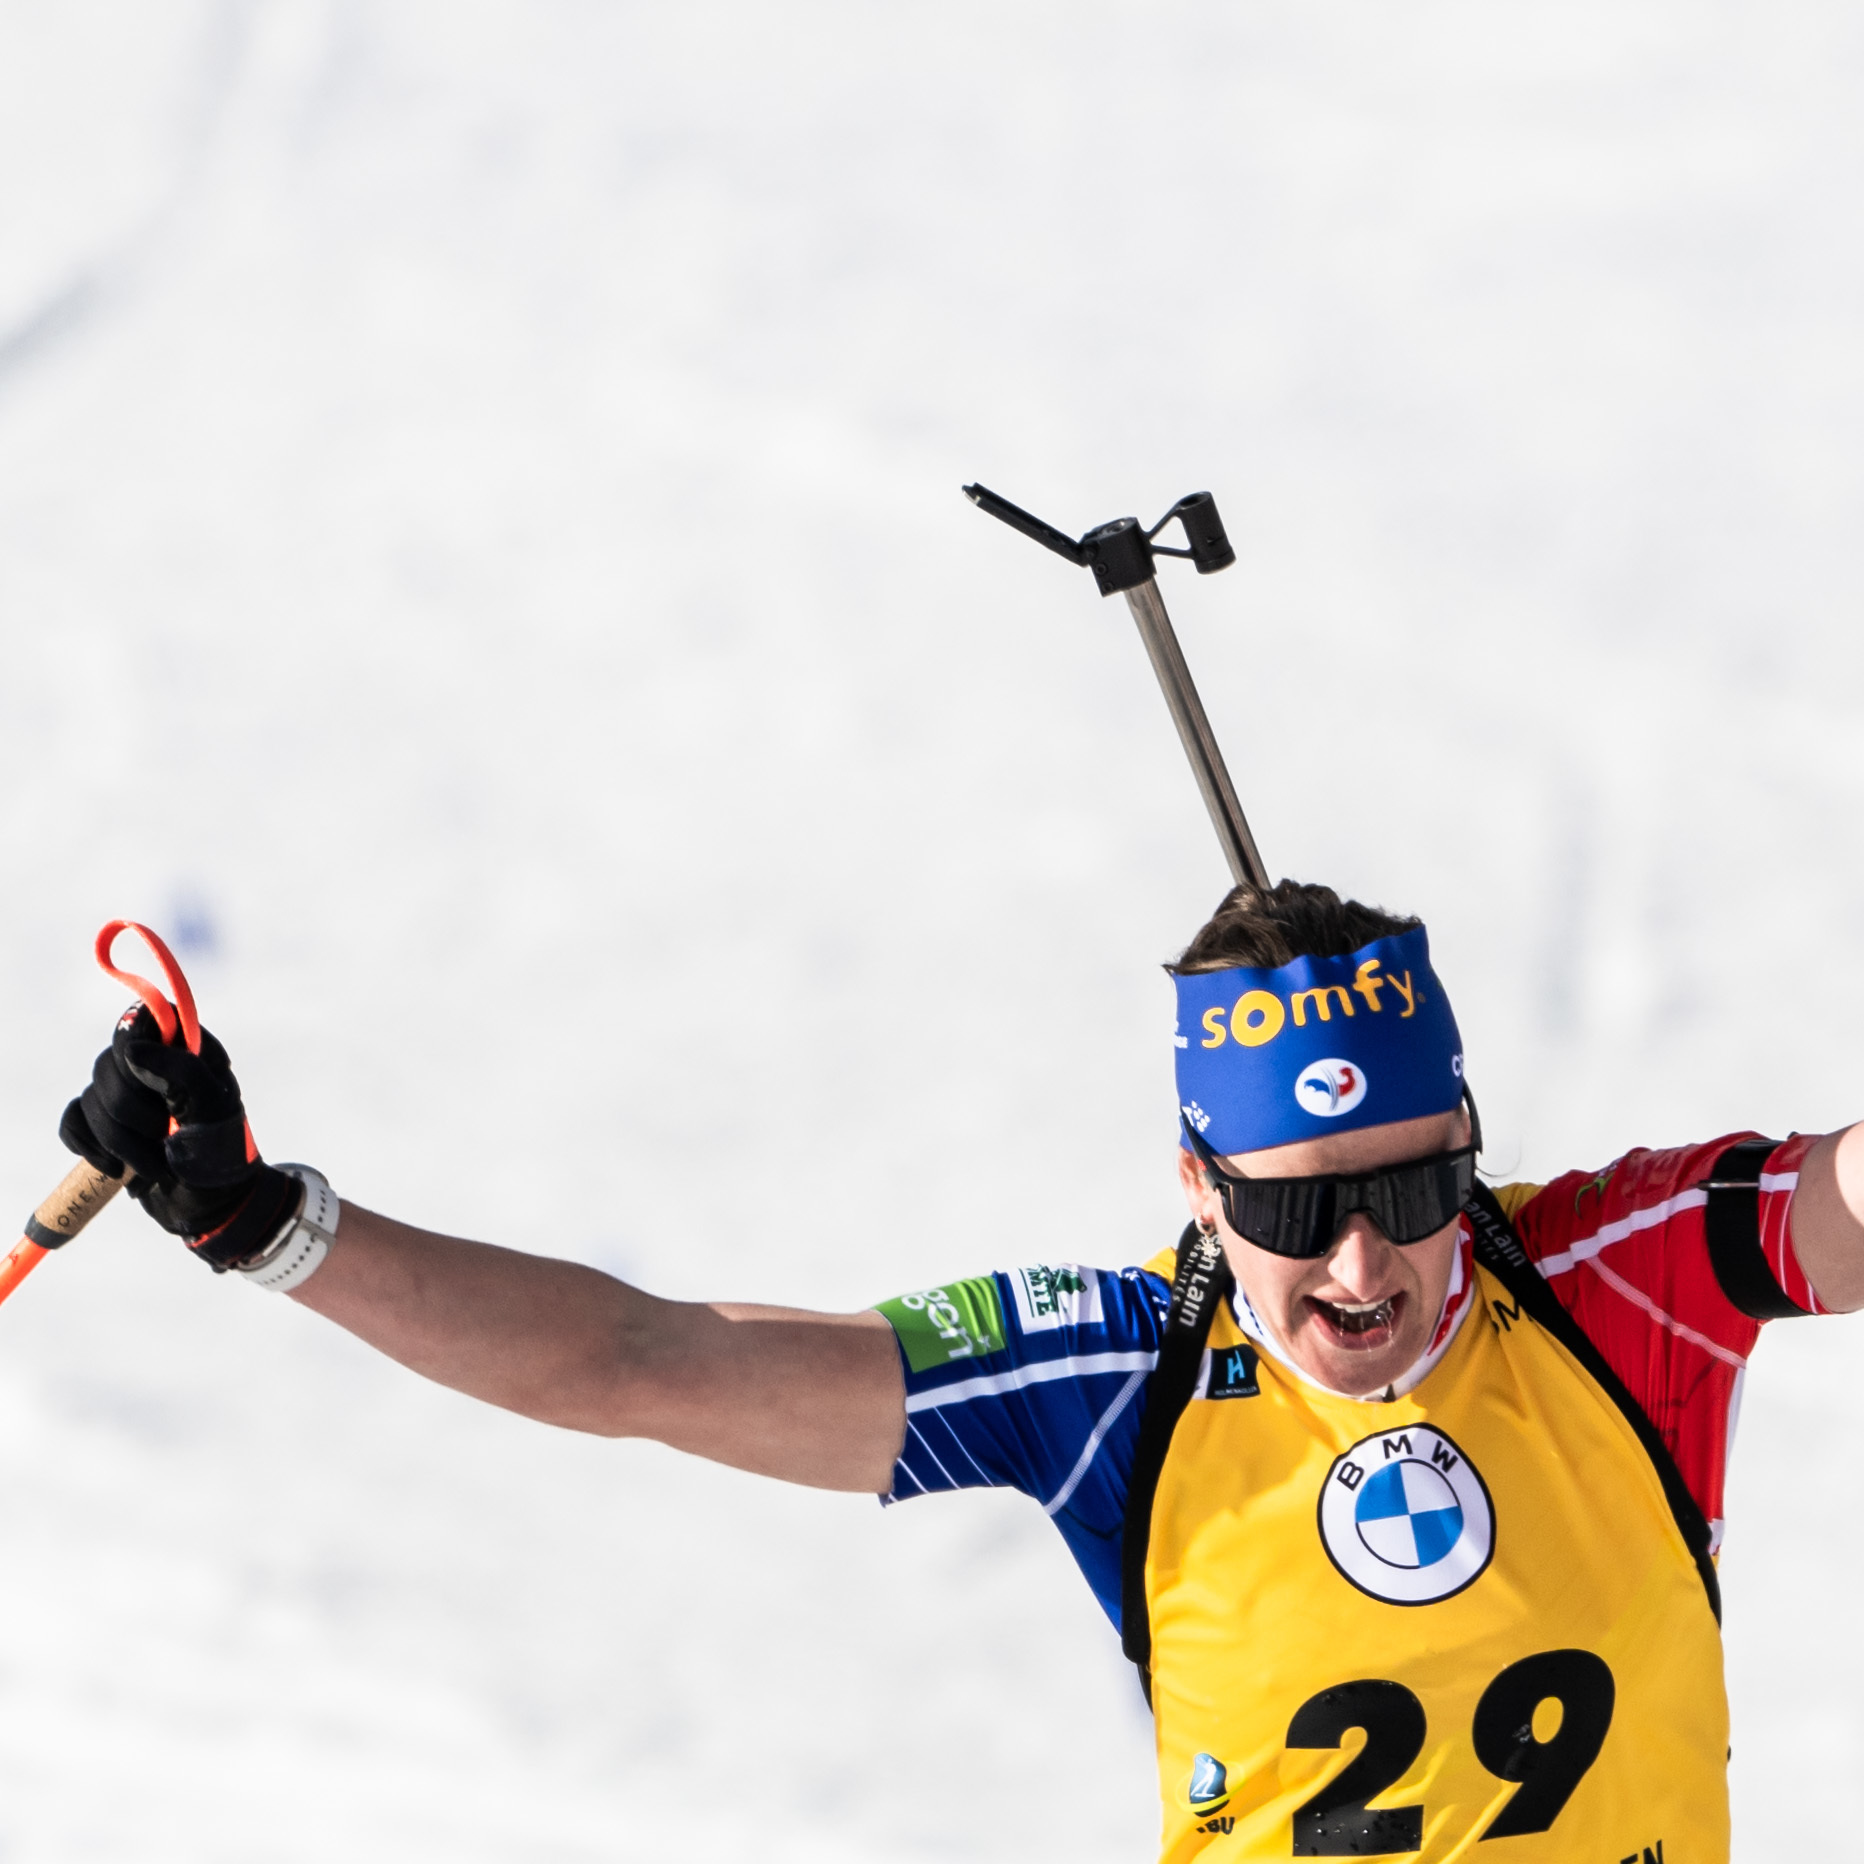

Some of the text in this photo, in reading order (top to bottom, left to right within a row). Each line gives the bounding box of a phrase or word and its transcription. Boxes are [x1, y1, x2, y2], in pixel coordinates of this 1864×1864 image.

[1201, 958, 1416, 1049] somfy
[1486, 1224, 1528, 1268] Lain
[1179, 1273, 1210, 1328] Lain
[1336, 1434, 1459, 1491] BMW
[1285, 1648, 1616, 1857] 29
